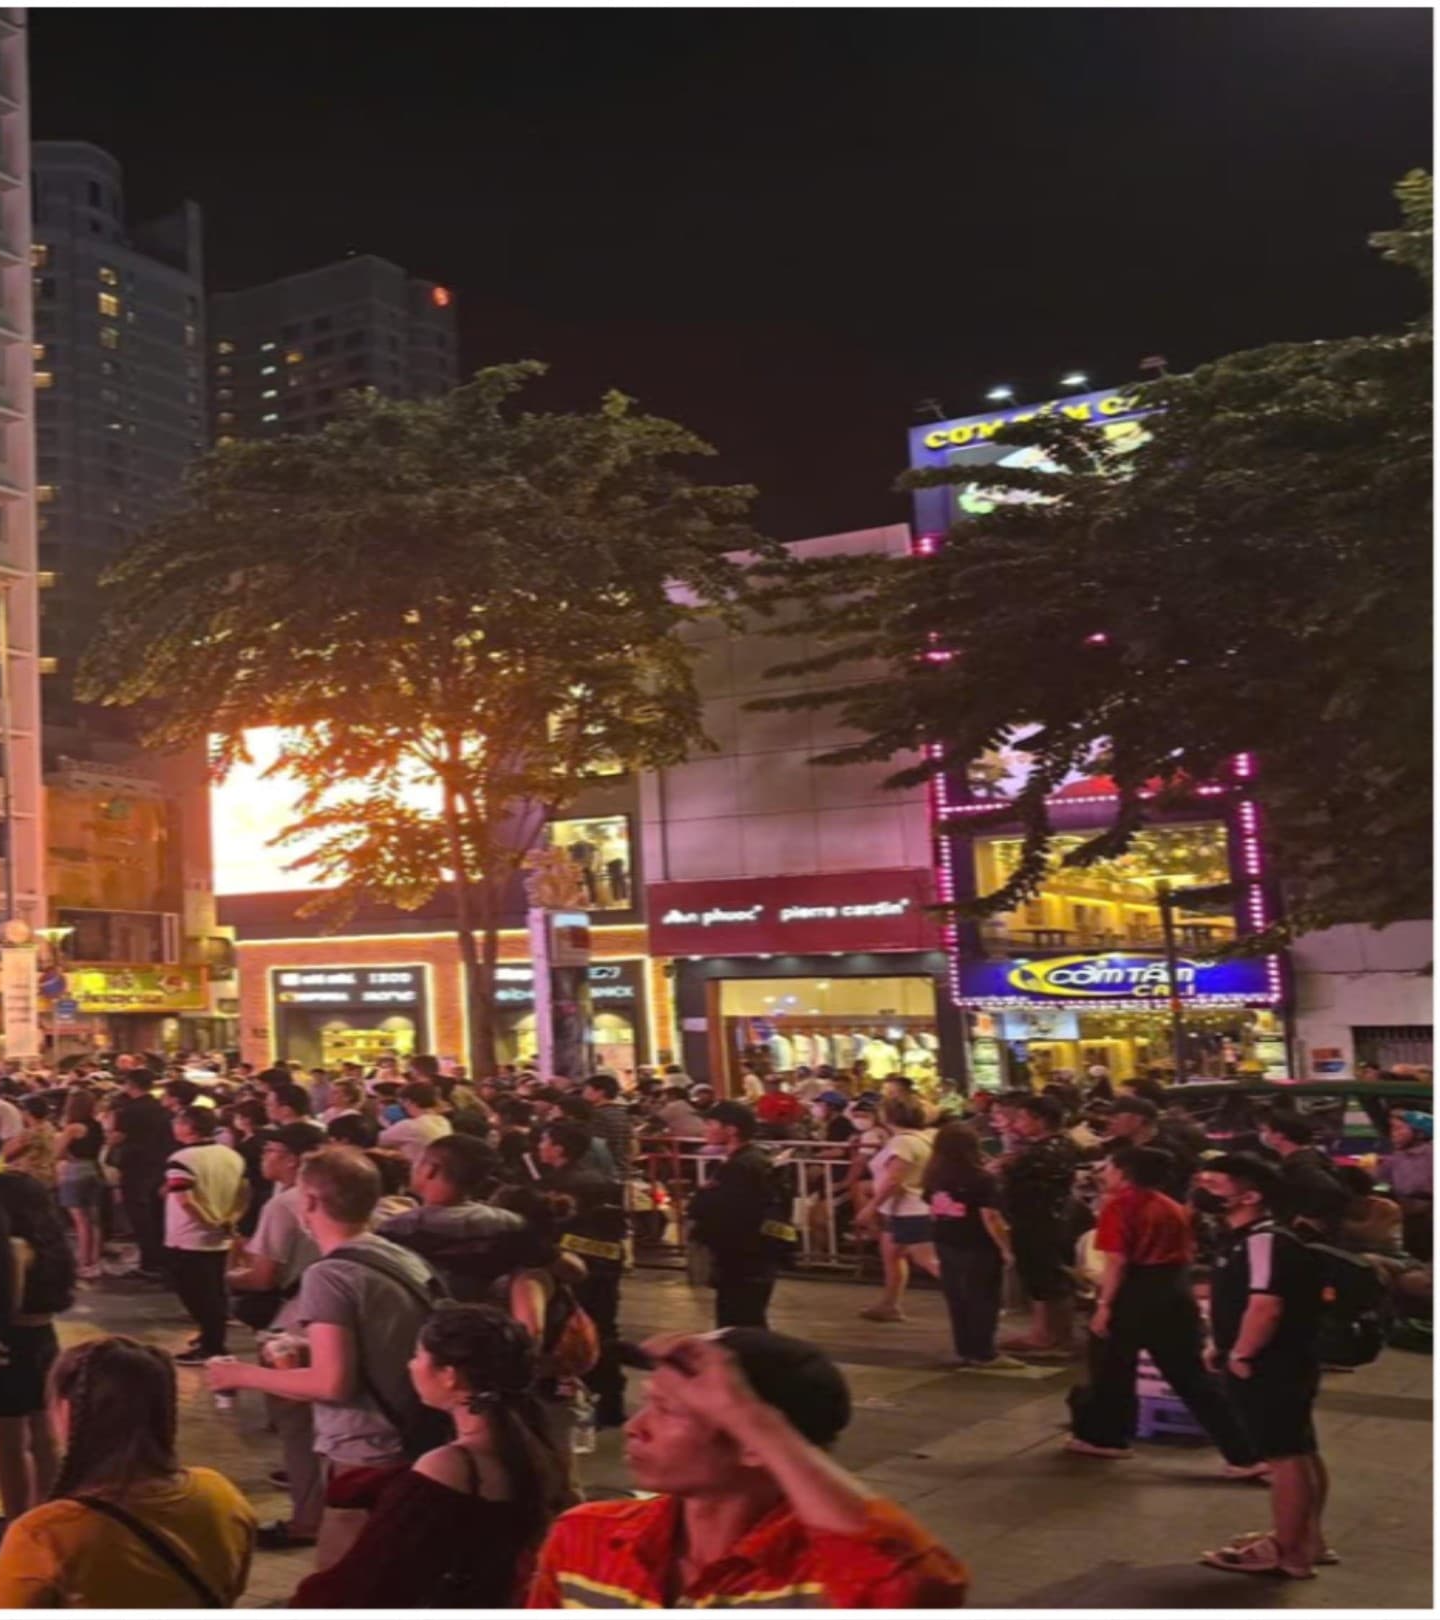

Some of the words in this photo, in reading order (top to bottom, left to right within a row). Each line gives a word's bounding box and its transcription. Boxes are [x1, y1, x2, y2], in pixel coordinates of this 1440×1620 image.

[780, 905, 836, 922] pierre
[840, 901, 904, 917] cardin
[1131, 983, 1195, 997] CAI
